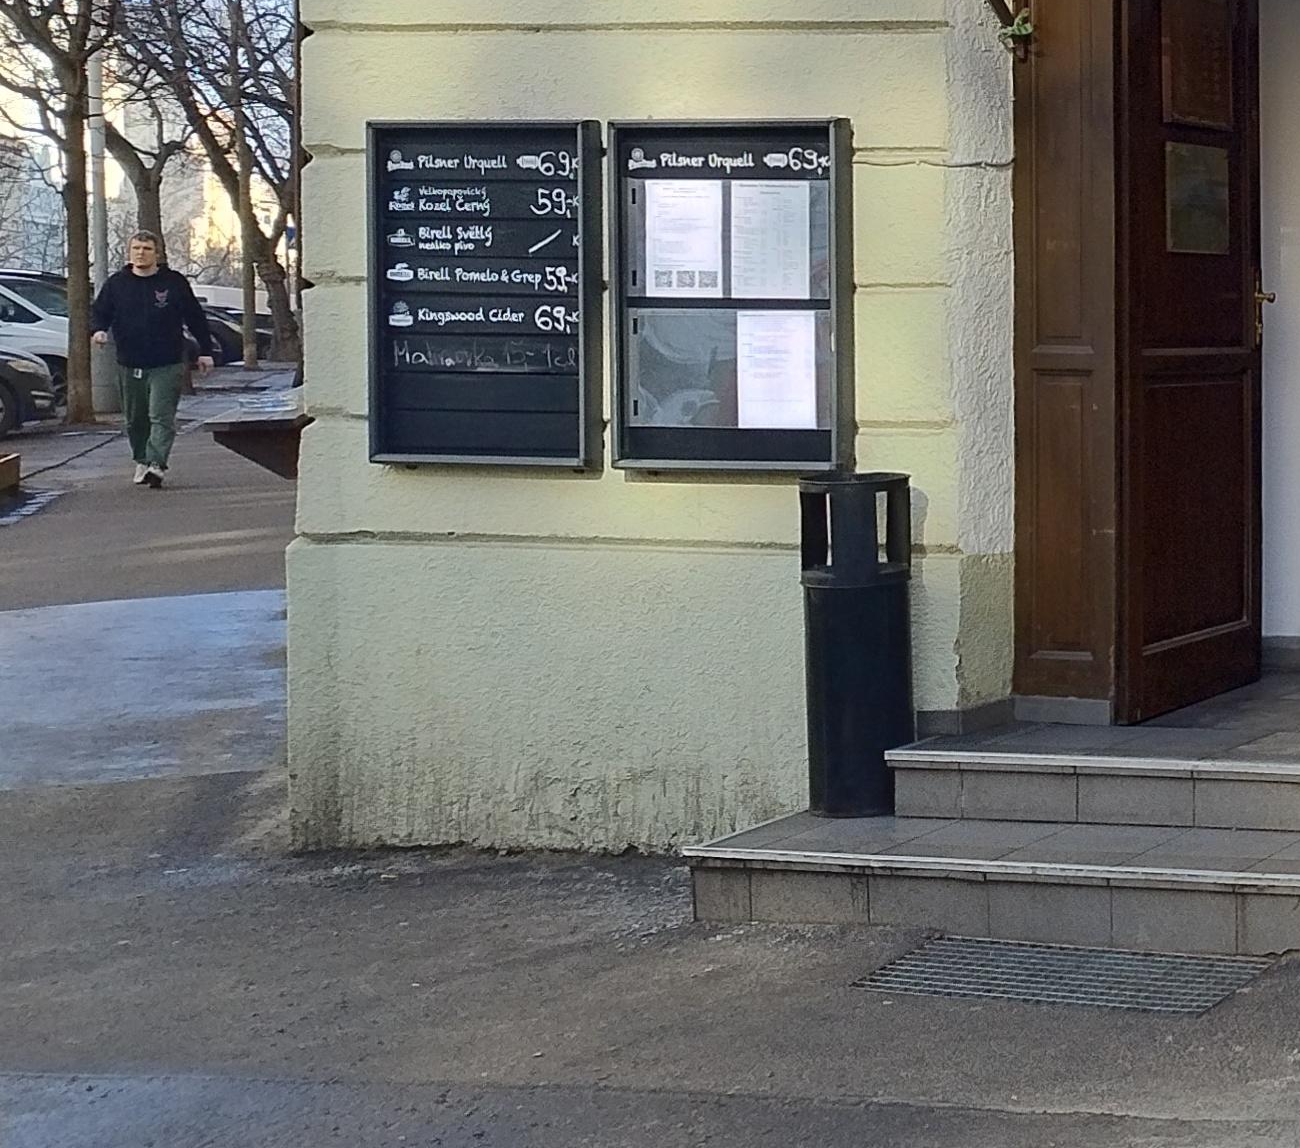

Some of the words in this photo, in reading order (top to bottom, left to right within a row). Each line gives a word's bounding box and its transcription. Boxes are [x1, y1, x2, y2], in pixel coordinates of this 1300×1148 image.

[417, 154, 460, 170] Pilsner
[463, 155, 508, 176] Urquell
[659, 152, 706, 168] Pilsner
[708, 151, 755, 174] Urquell
[418, 202, 452, 212] Kozel
[455, 196, 491, 217] Černý
[418, 226, 453, 241] Birell
[454, 240, 476, 256] pivo
[417, 267, 451, 282] Birell
[455, 267, 500, 283] Pomelo
[500, 269, 510, 284] &
[511, 269, 543, 291] Grep
[417, 307, 486, 327] Kingswood
[488, 308, 525, 323] Cider
